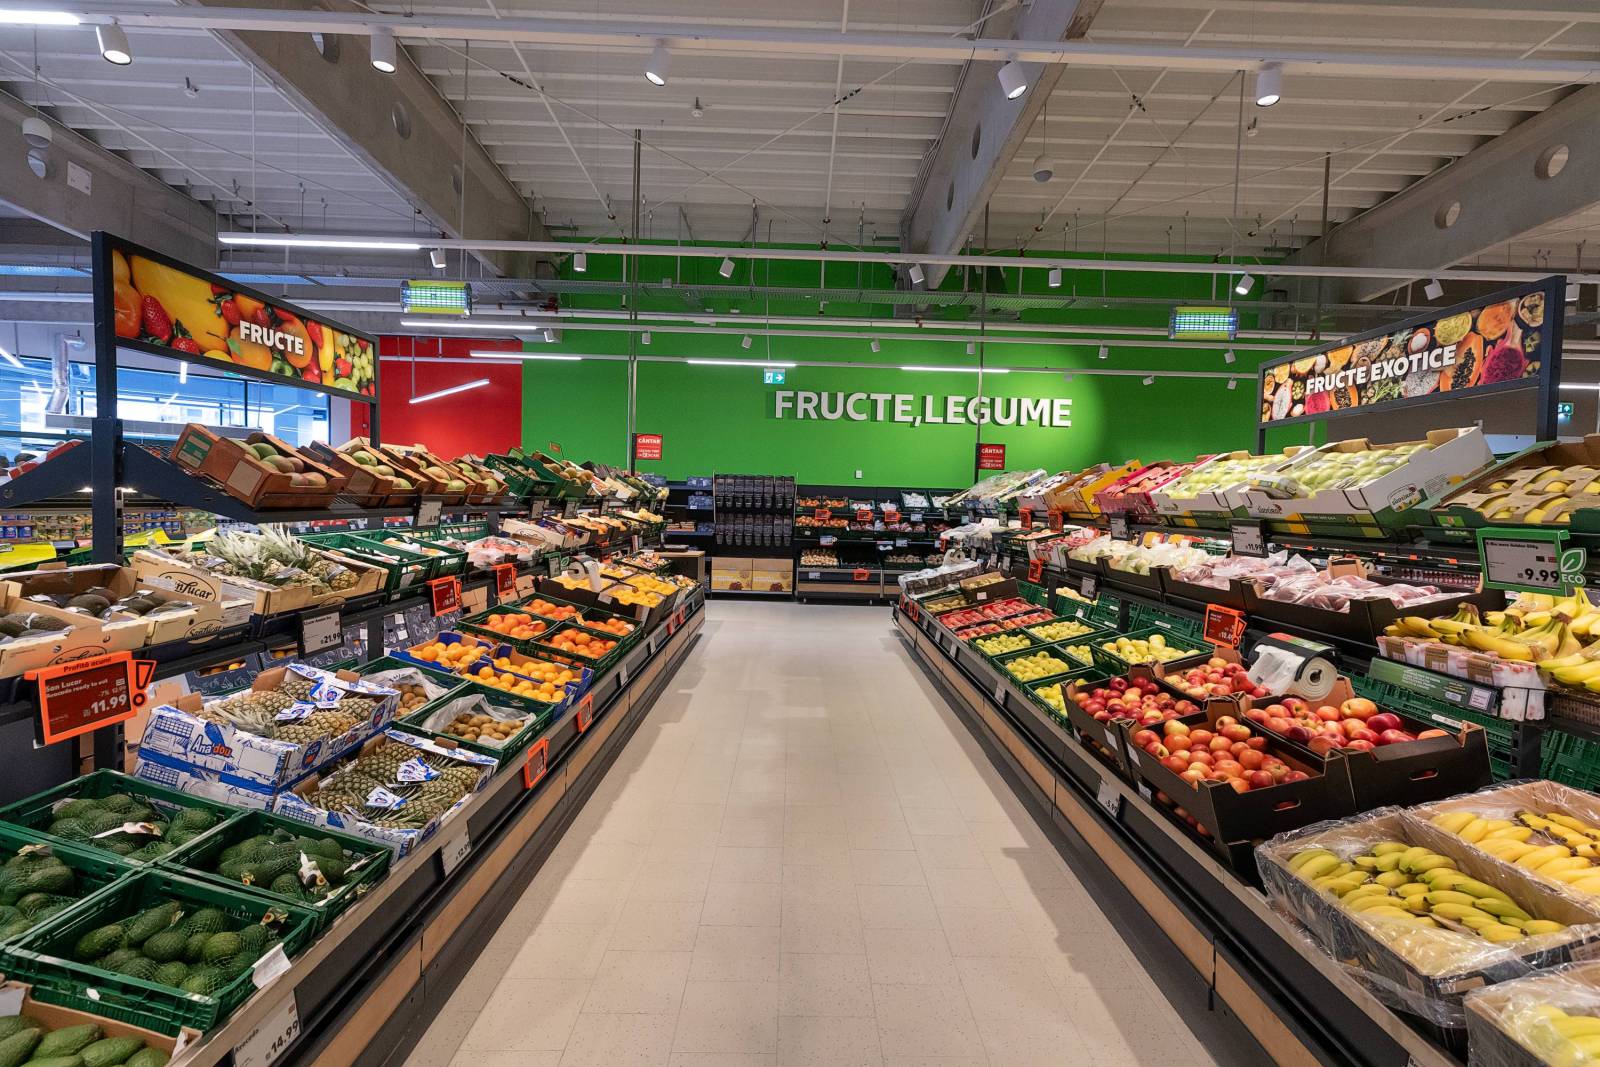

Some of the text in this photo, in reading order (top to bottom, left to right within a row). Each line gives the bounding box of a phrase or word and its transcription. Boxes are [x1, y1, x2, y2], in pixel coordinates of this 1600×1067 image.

[239, 319, 304, 356] FRUCTE
[1305, 344, 1457, 395] FRUCTE EXOTICE
[1524, 567, 1561, 583] 9.99
[1561, 573, 1585, 584] ECO
[324, 632, 341, 644] 21.99
[61, 679, 82, 689] Lucar
[72, 682, 91, 693] ready
[91, 693, 127, 715] 11.99
[270, 1019, 300, 1054] 14.99
